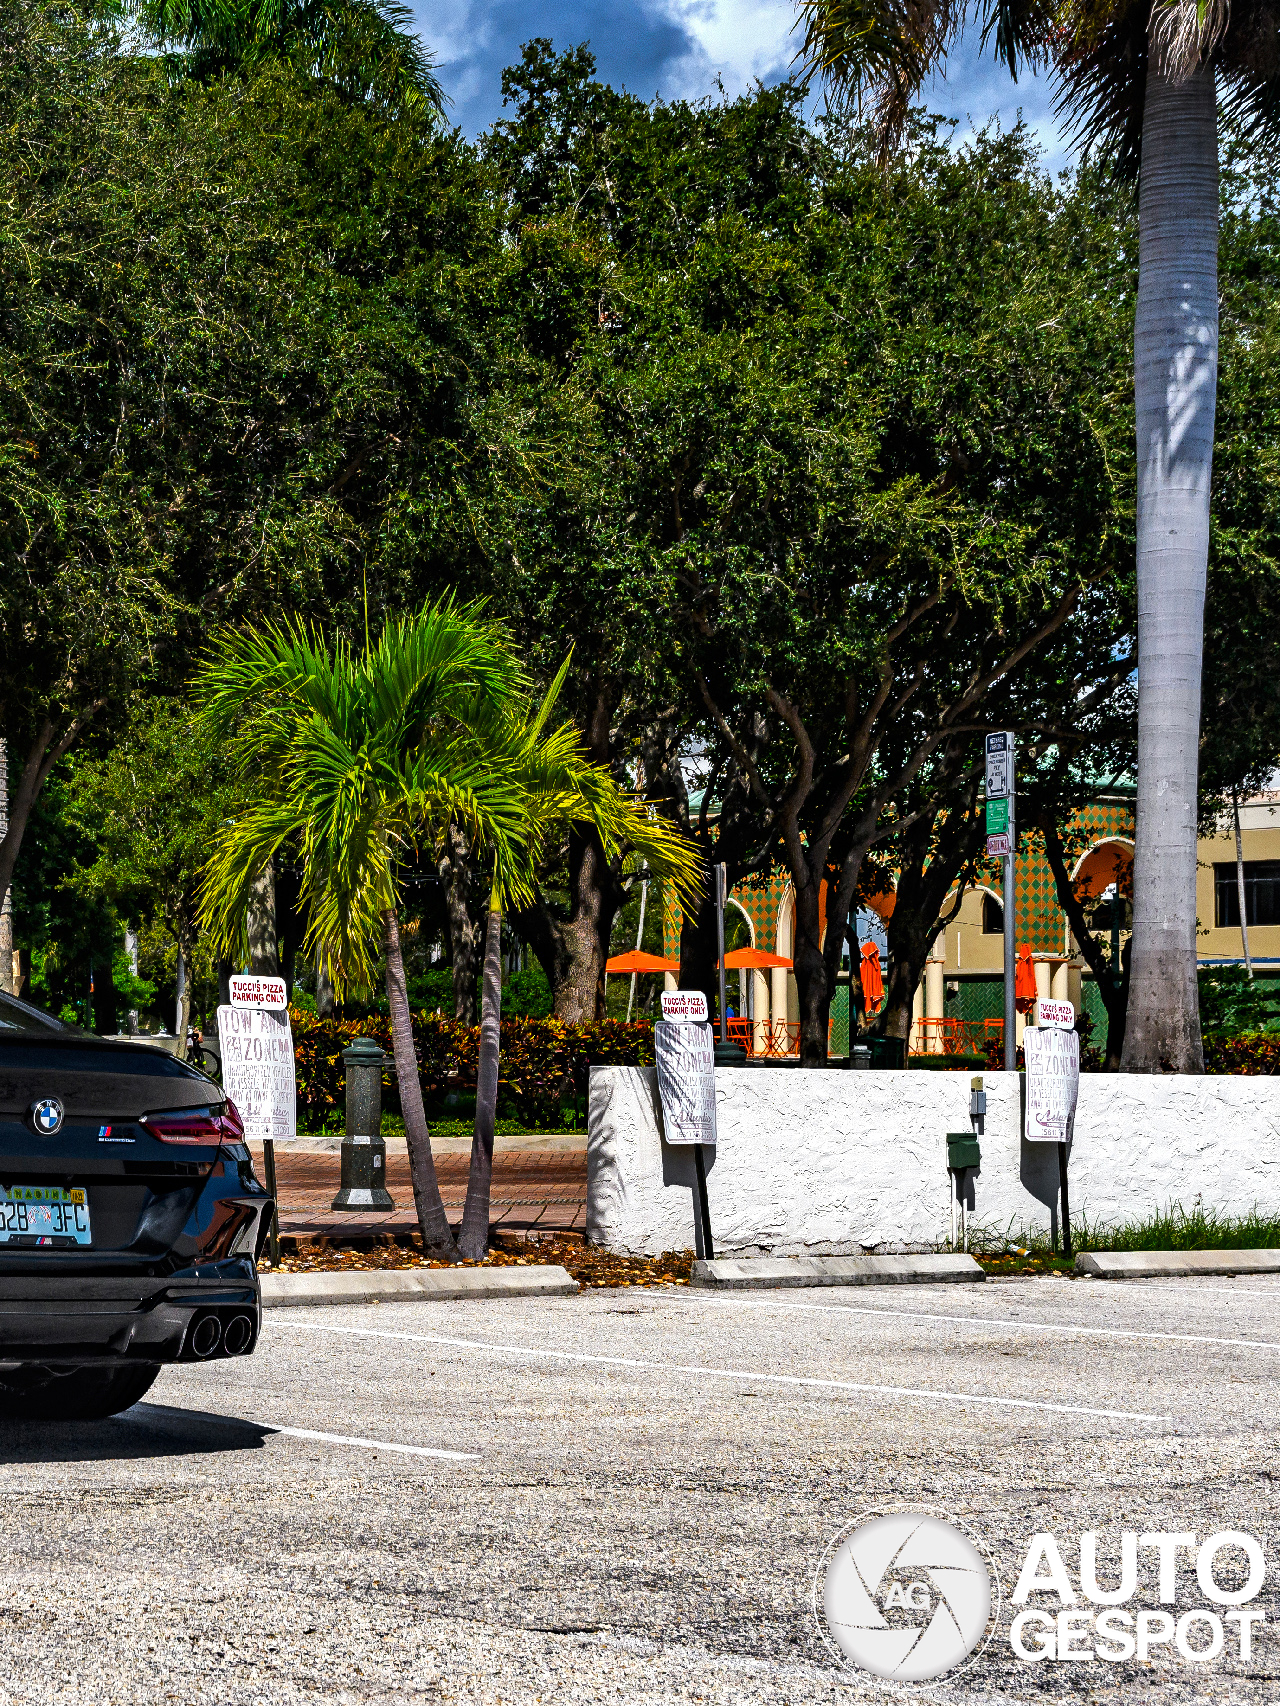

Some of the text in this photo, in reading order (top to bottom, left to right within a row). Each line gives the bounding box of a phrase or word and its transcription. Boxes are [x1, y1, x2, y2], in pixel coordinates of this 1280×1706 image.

[233, 982, 284, 994] TUCCI'S PIZZA
[232, 991, 285, 1004] PARKING ONLY
[687, 998, 704, 1006] PIZZA
[663, 1006, 706, 1015] PARKING ONLY
[222, 1010, 252, 1033] TOW
[244, 1038, 278, 1061] ZONE
[1028, 1031, 1052, 1052] TOW
[51, 1203, 86, 1233] 3FC
